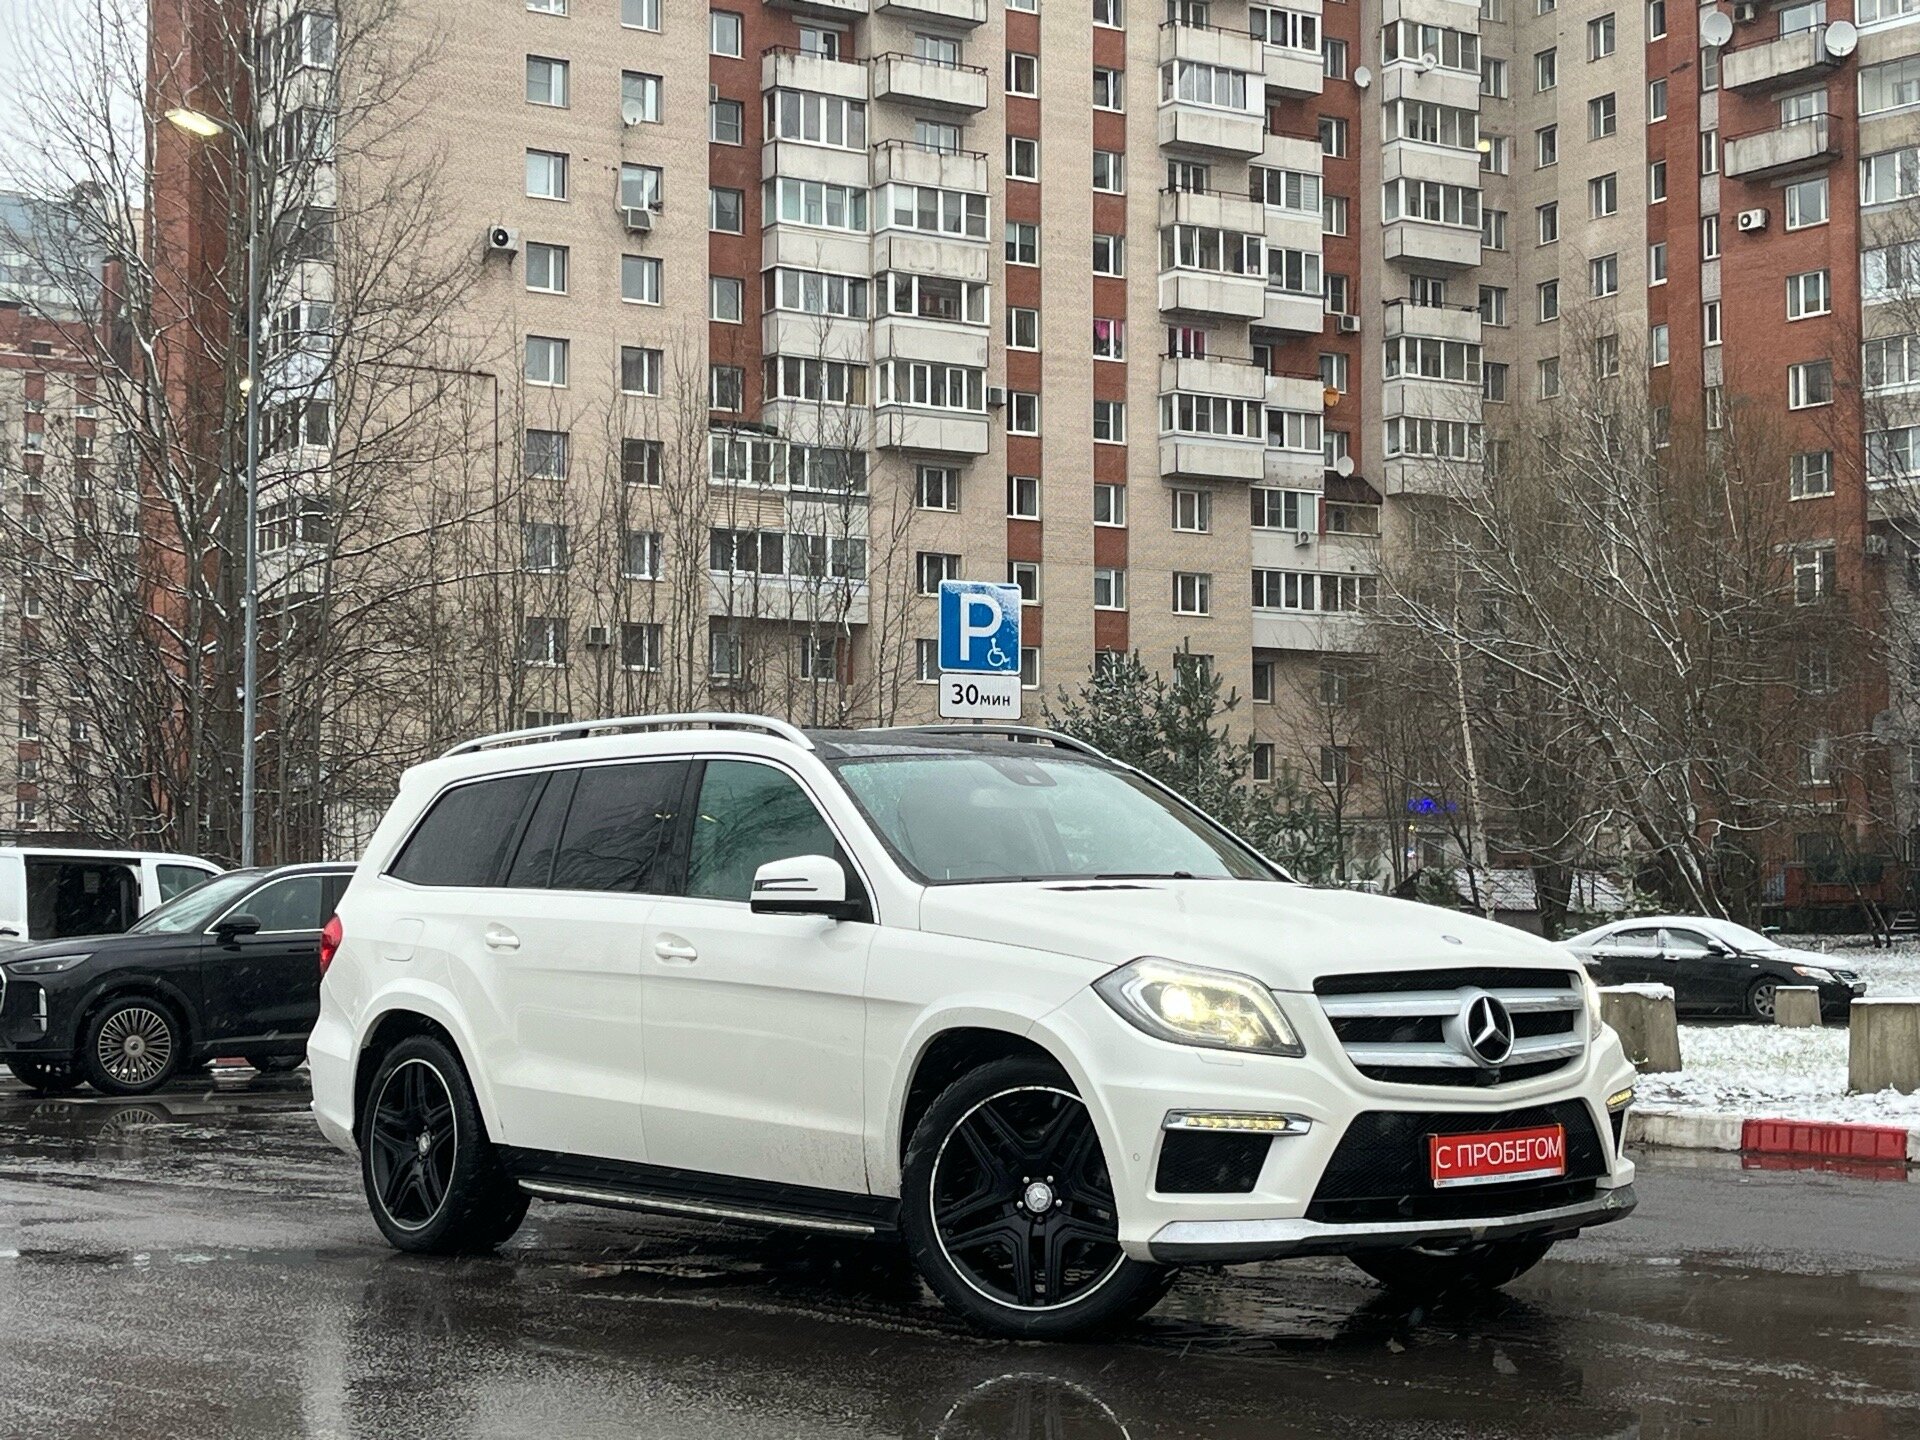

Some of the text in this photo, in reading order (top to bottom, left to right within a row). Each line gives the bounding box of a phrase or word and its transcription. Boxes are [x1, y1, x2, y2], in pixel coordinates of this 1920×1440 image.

[960, 593, 1002, 661] P
[1436, 1135, 1562, 1169] С ПРОБЕГОМ
